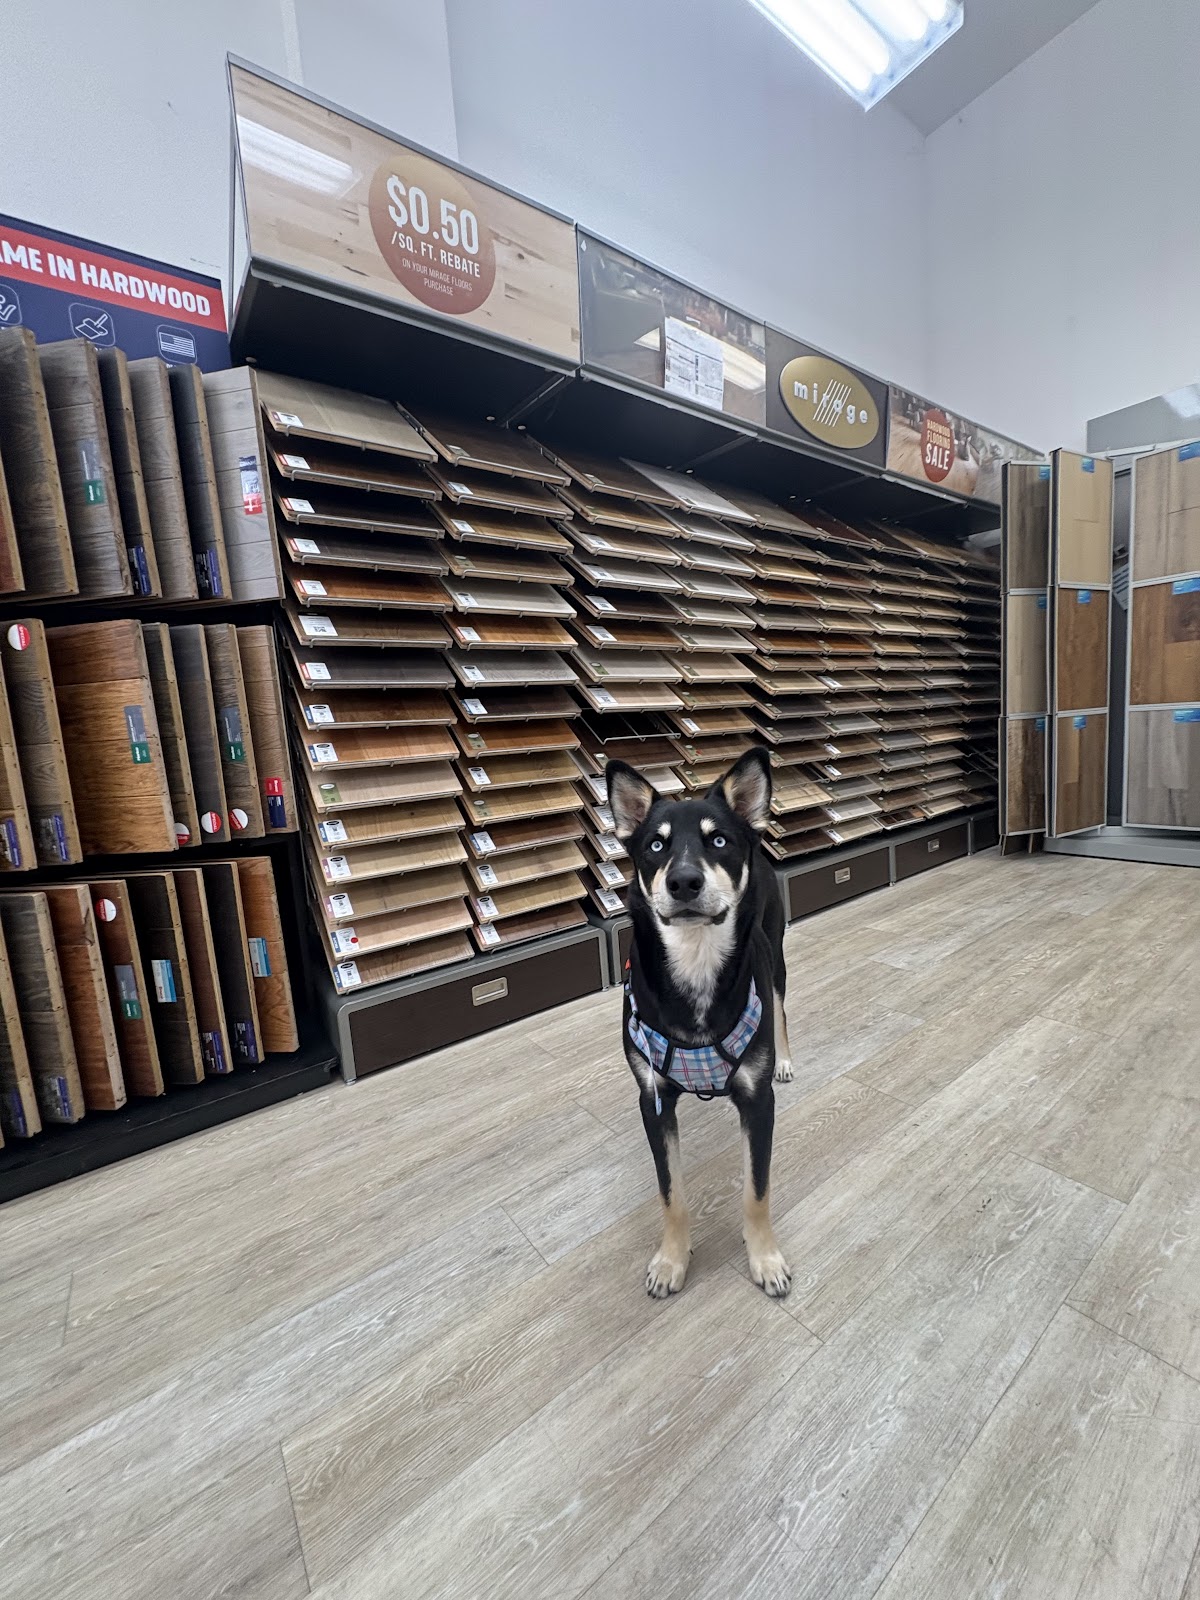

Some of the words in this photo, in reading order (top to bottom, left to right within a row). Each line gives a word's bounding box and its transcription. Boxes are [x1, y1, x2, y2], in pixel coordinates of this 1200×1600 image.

[387, 175, 479, 255] $0.50
[391, 231, 418, 254] /SQ.
[421, 242, 437, 262] FT.
[440, 249, 481, 278] REBATE
[0, 240, 43, 274] ME
[47, 253, 76, 282] IN
[80, 262, 211, 316] HARDWOOD
[402, 257, 412, 269] ON
[412, 261, 428, 275] YOUR
[429, 267, 450, 284] MIRAGE
[451, 276, 473, 291] FLOORS
[424, 278, 454, 296] PURCHASE
[794, 382, 868, 425] mirage
[925, 443, 951, 470] SALE
[926, 430, 951, 450] FLOORING
[18, 626, 26, 648] SPECIAL
